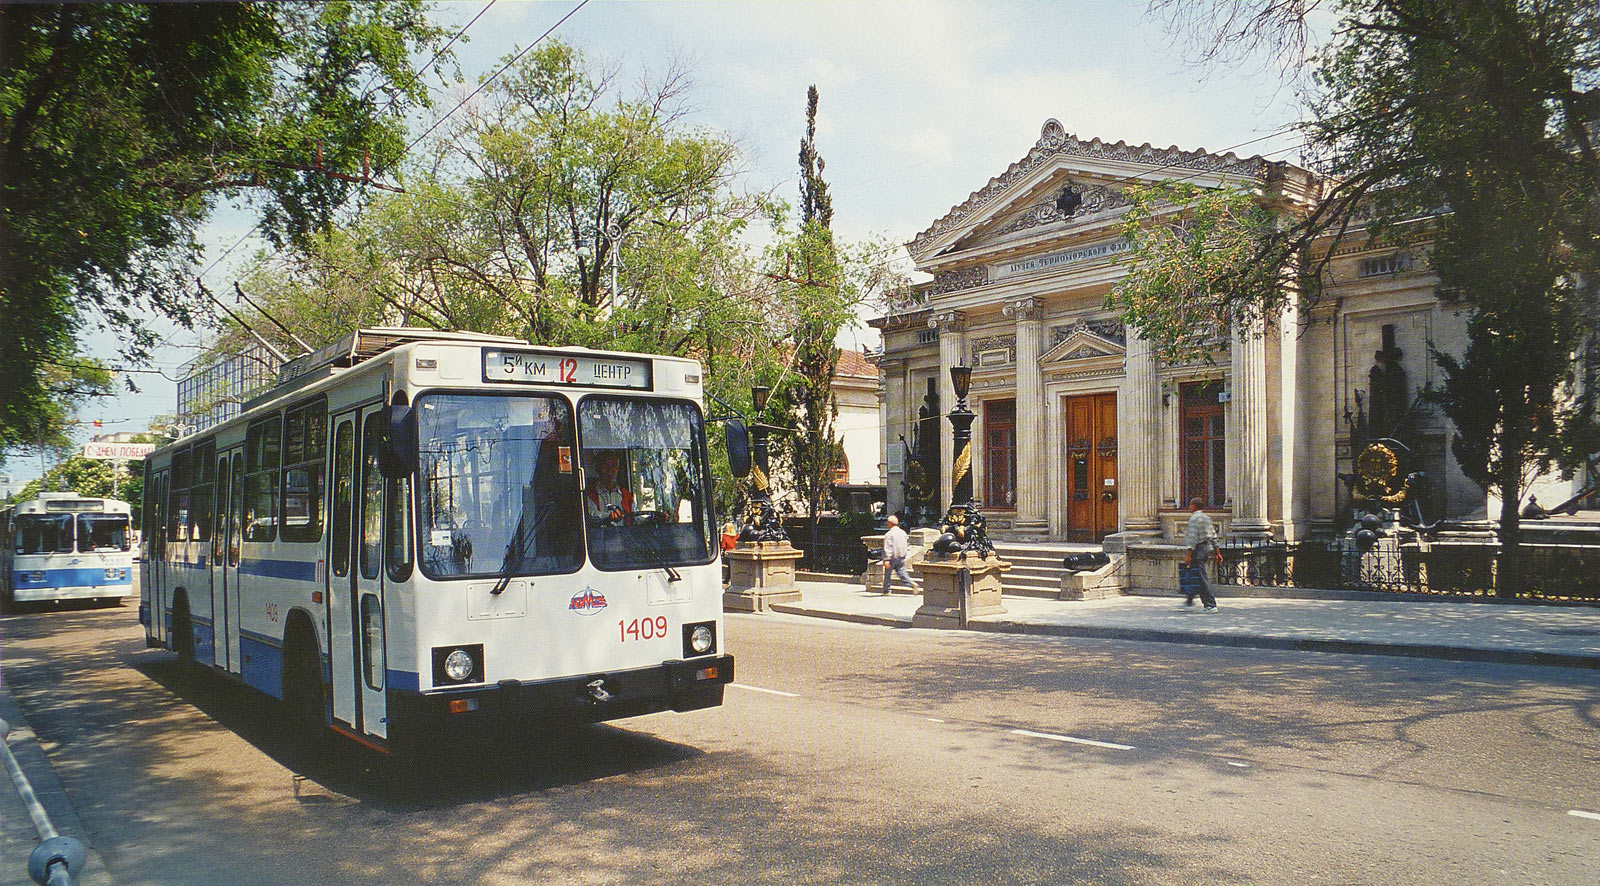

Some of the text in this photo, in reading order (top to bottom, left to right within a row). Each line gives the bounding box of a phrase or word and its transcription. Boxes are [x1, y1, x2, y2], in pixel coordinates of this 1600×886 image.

[525, 361, 546, 376] КМ
[558, 358, 578, 382] 12
[593, 363, 631, 379] ЦЕНТР
[266, 603, 278, 622] 1409
[618, 615, 668, 643] 1409
